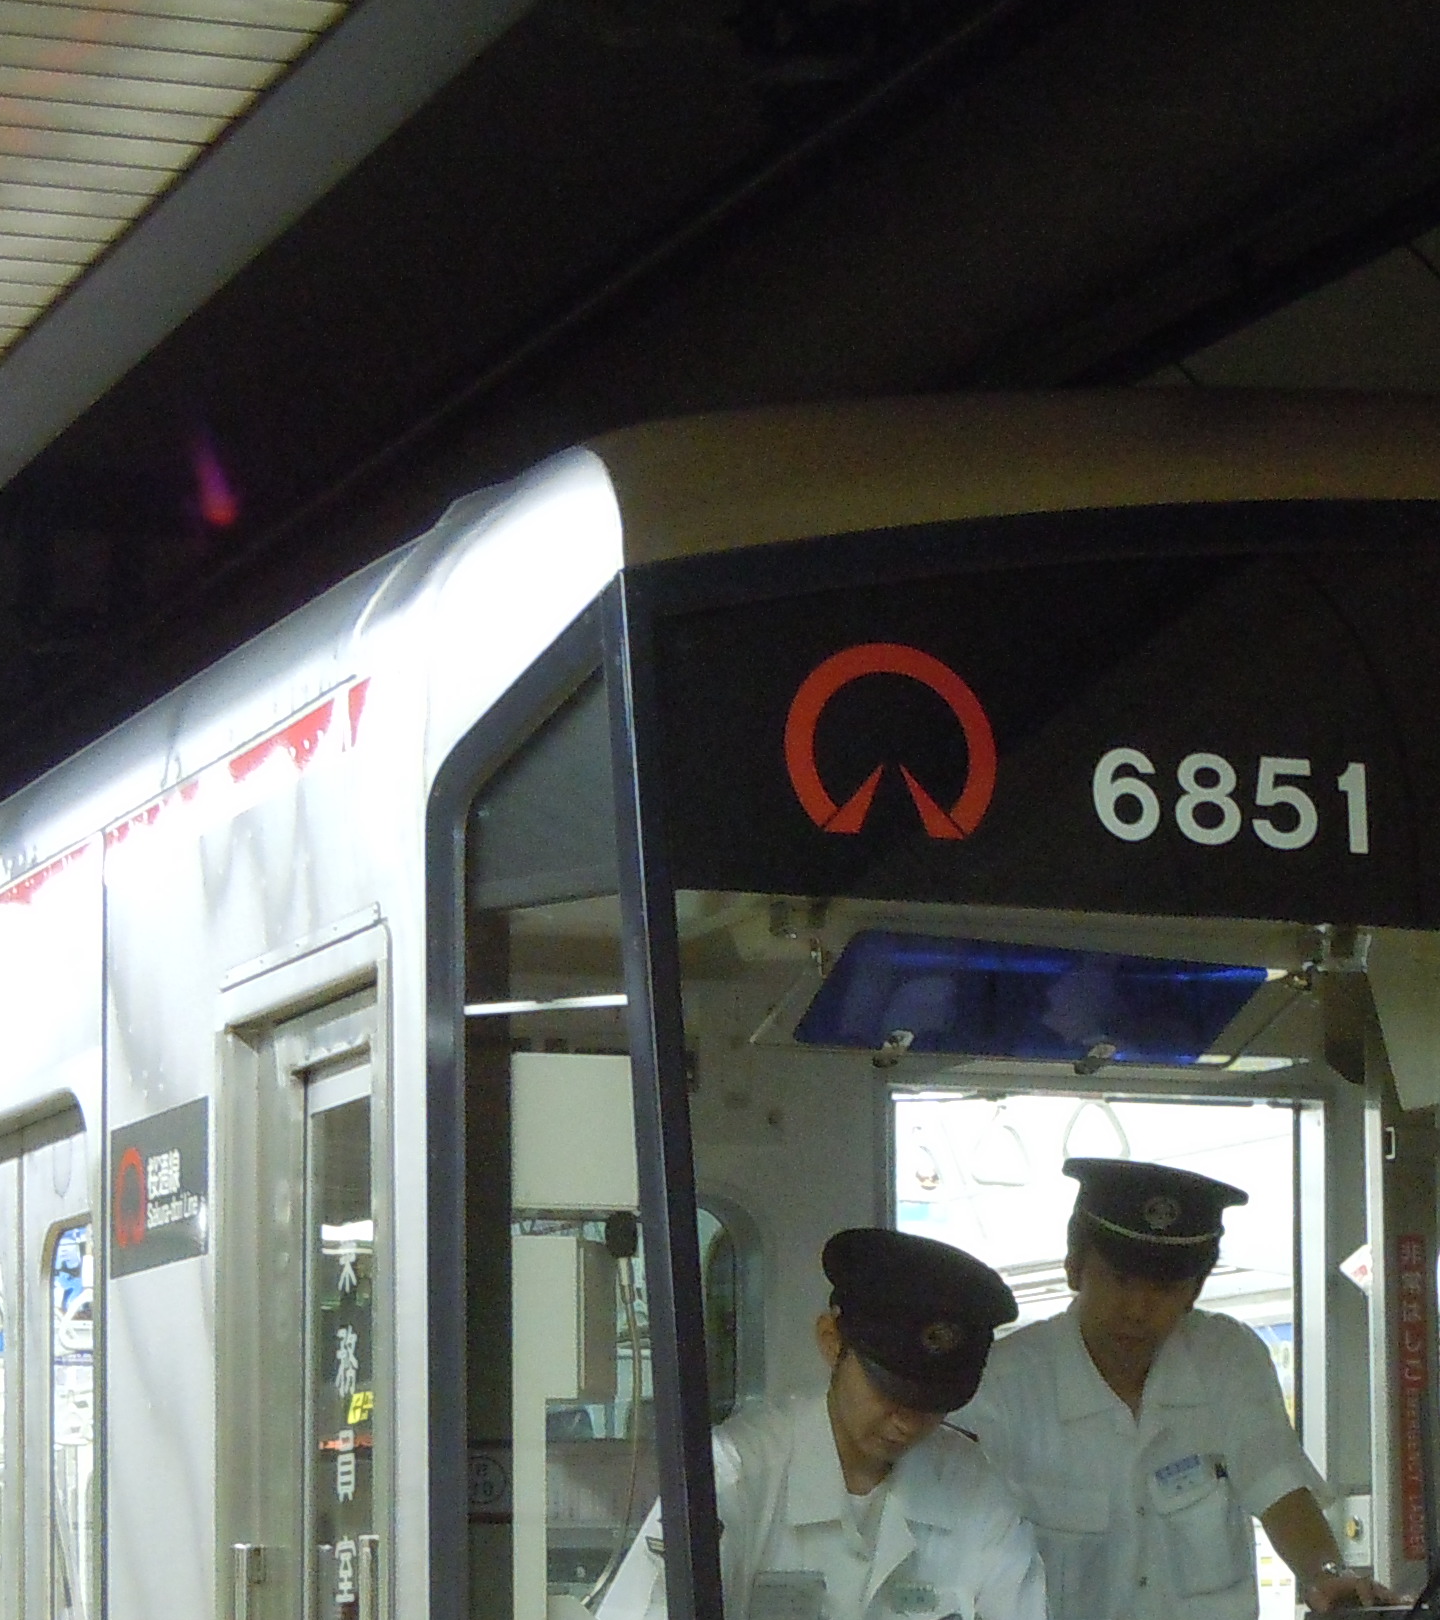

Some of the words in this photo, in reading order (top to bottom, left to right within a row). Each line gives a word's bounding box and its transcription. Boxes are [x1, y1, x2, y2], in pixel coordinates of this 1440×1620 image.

[1092, 747, 1370, 855] 6851
[147, 1147, 181, 1201] 桜通線
